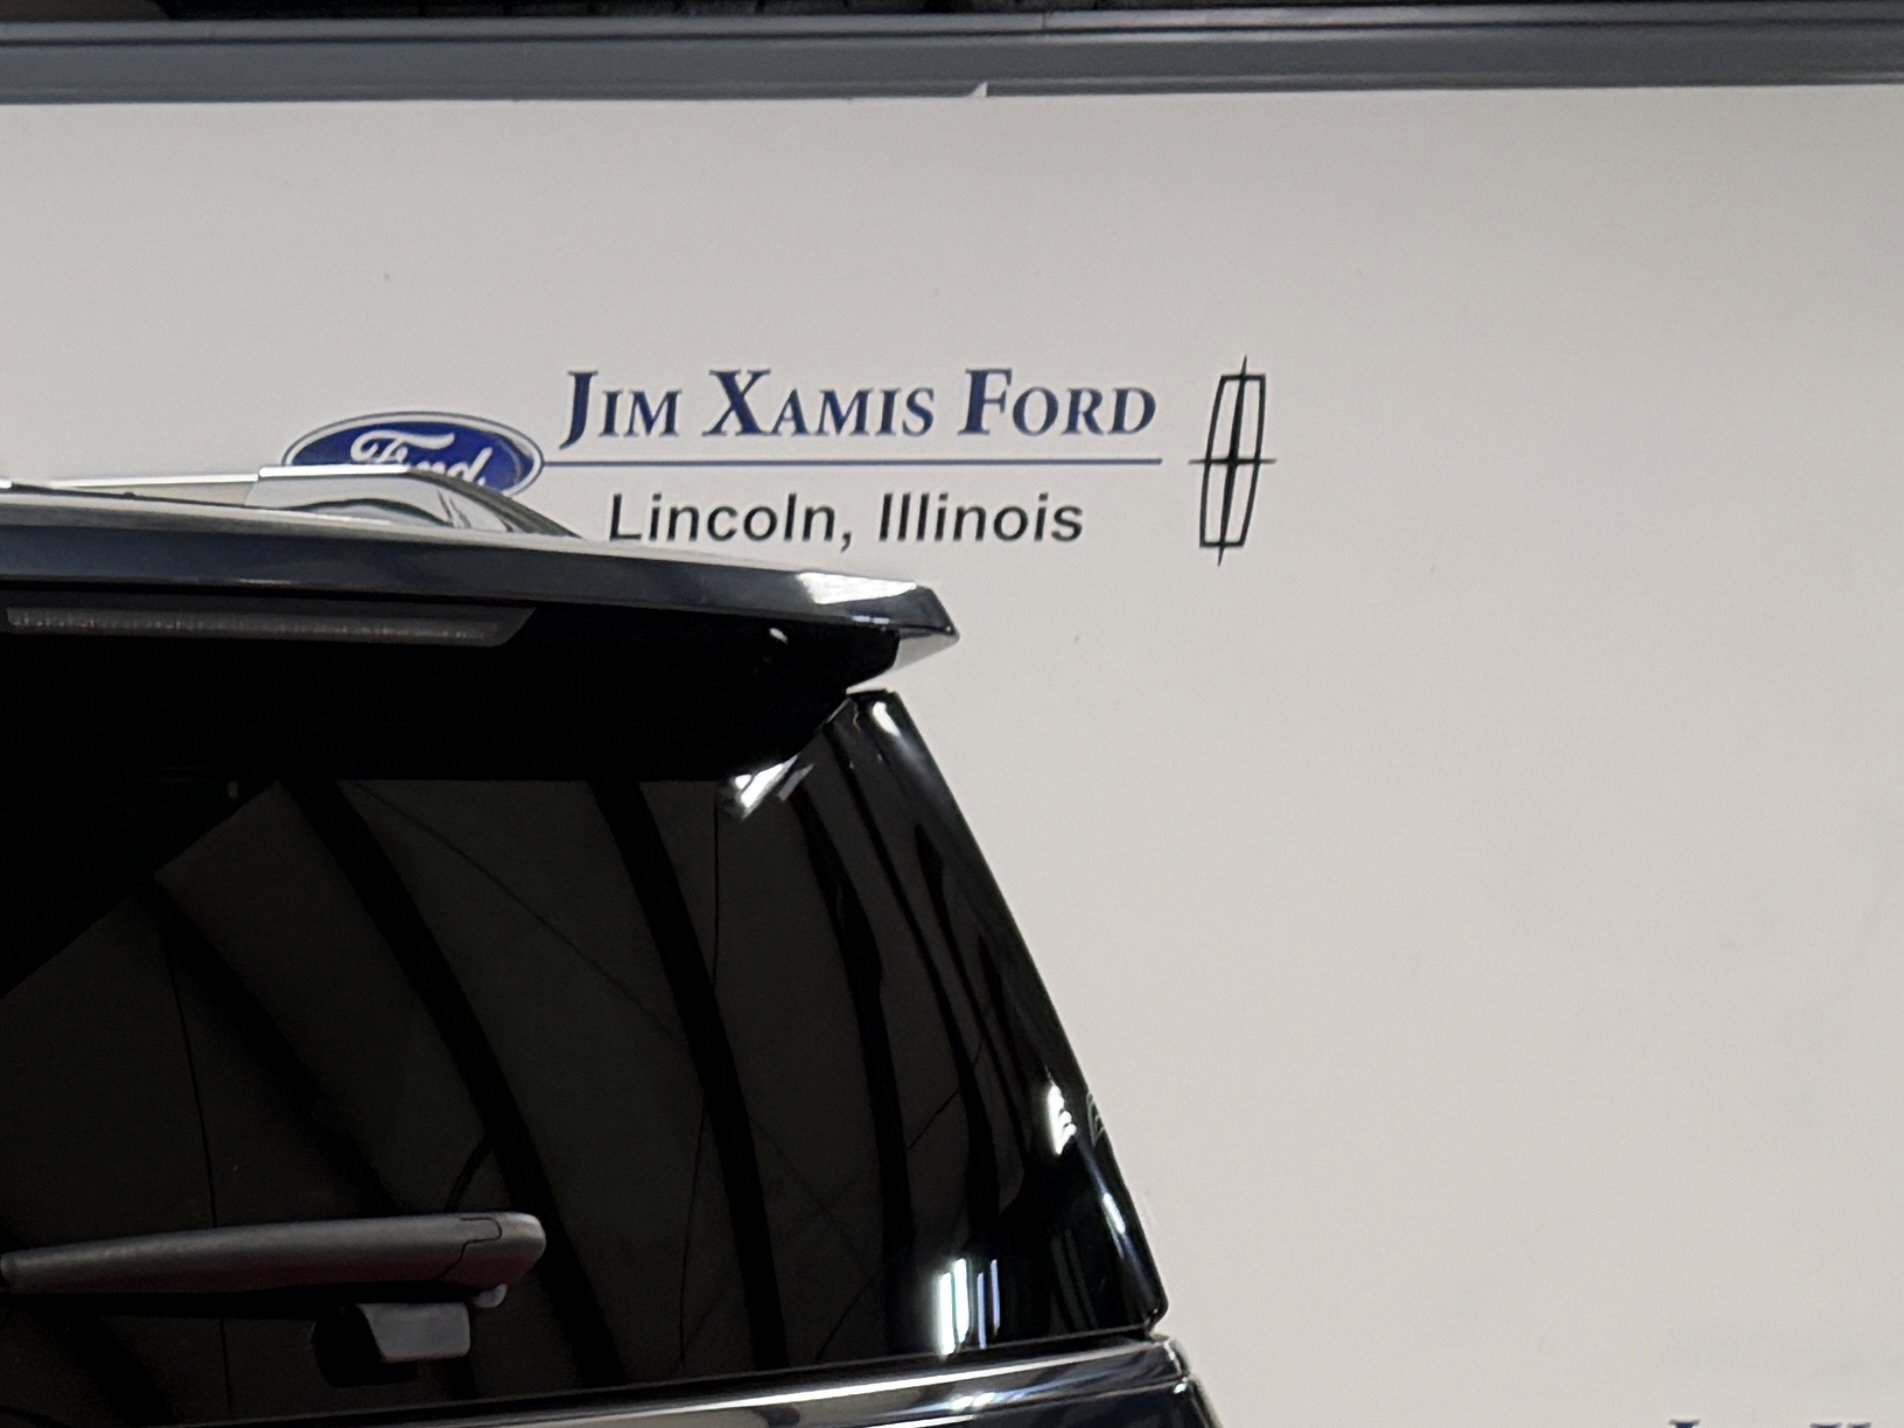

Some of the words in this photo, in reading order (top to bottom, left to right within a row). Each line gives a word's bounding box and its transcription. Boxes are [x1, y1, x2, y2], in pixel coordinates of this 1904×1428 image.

[559, 368, 679, 451] JIM
[701, 368, 935, 438] XAMIS
[958, 366, 1157, 438] FORD
[608, 492, 853, 551] Lincoln,
[878, 490, 1085, 544] Illinois
